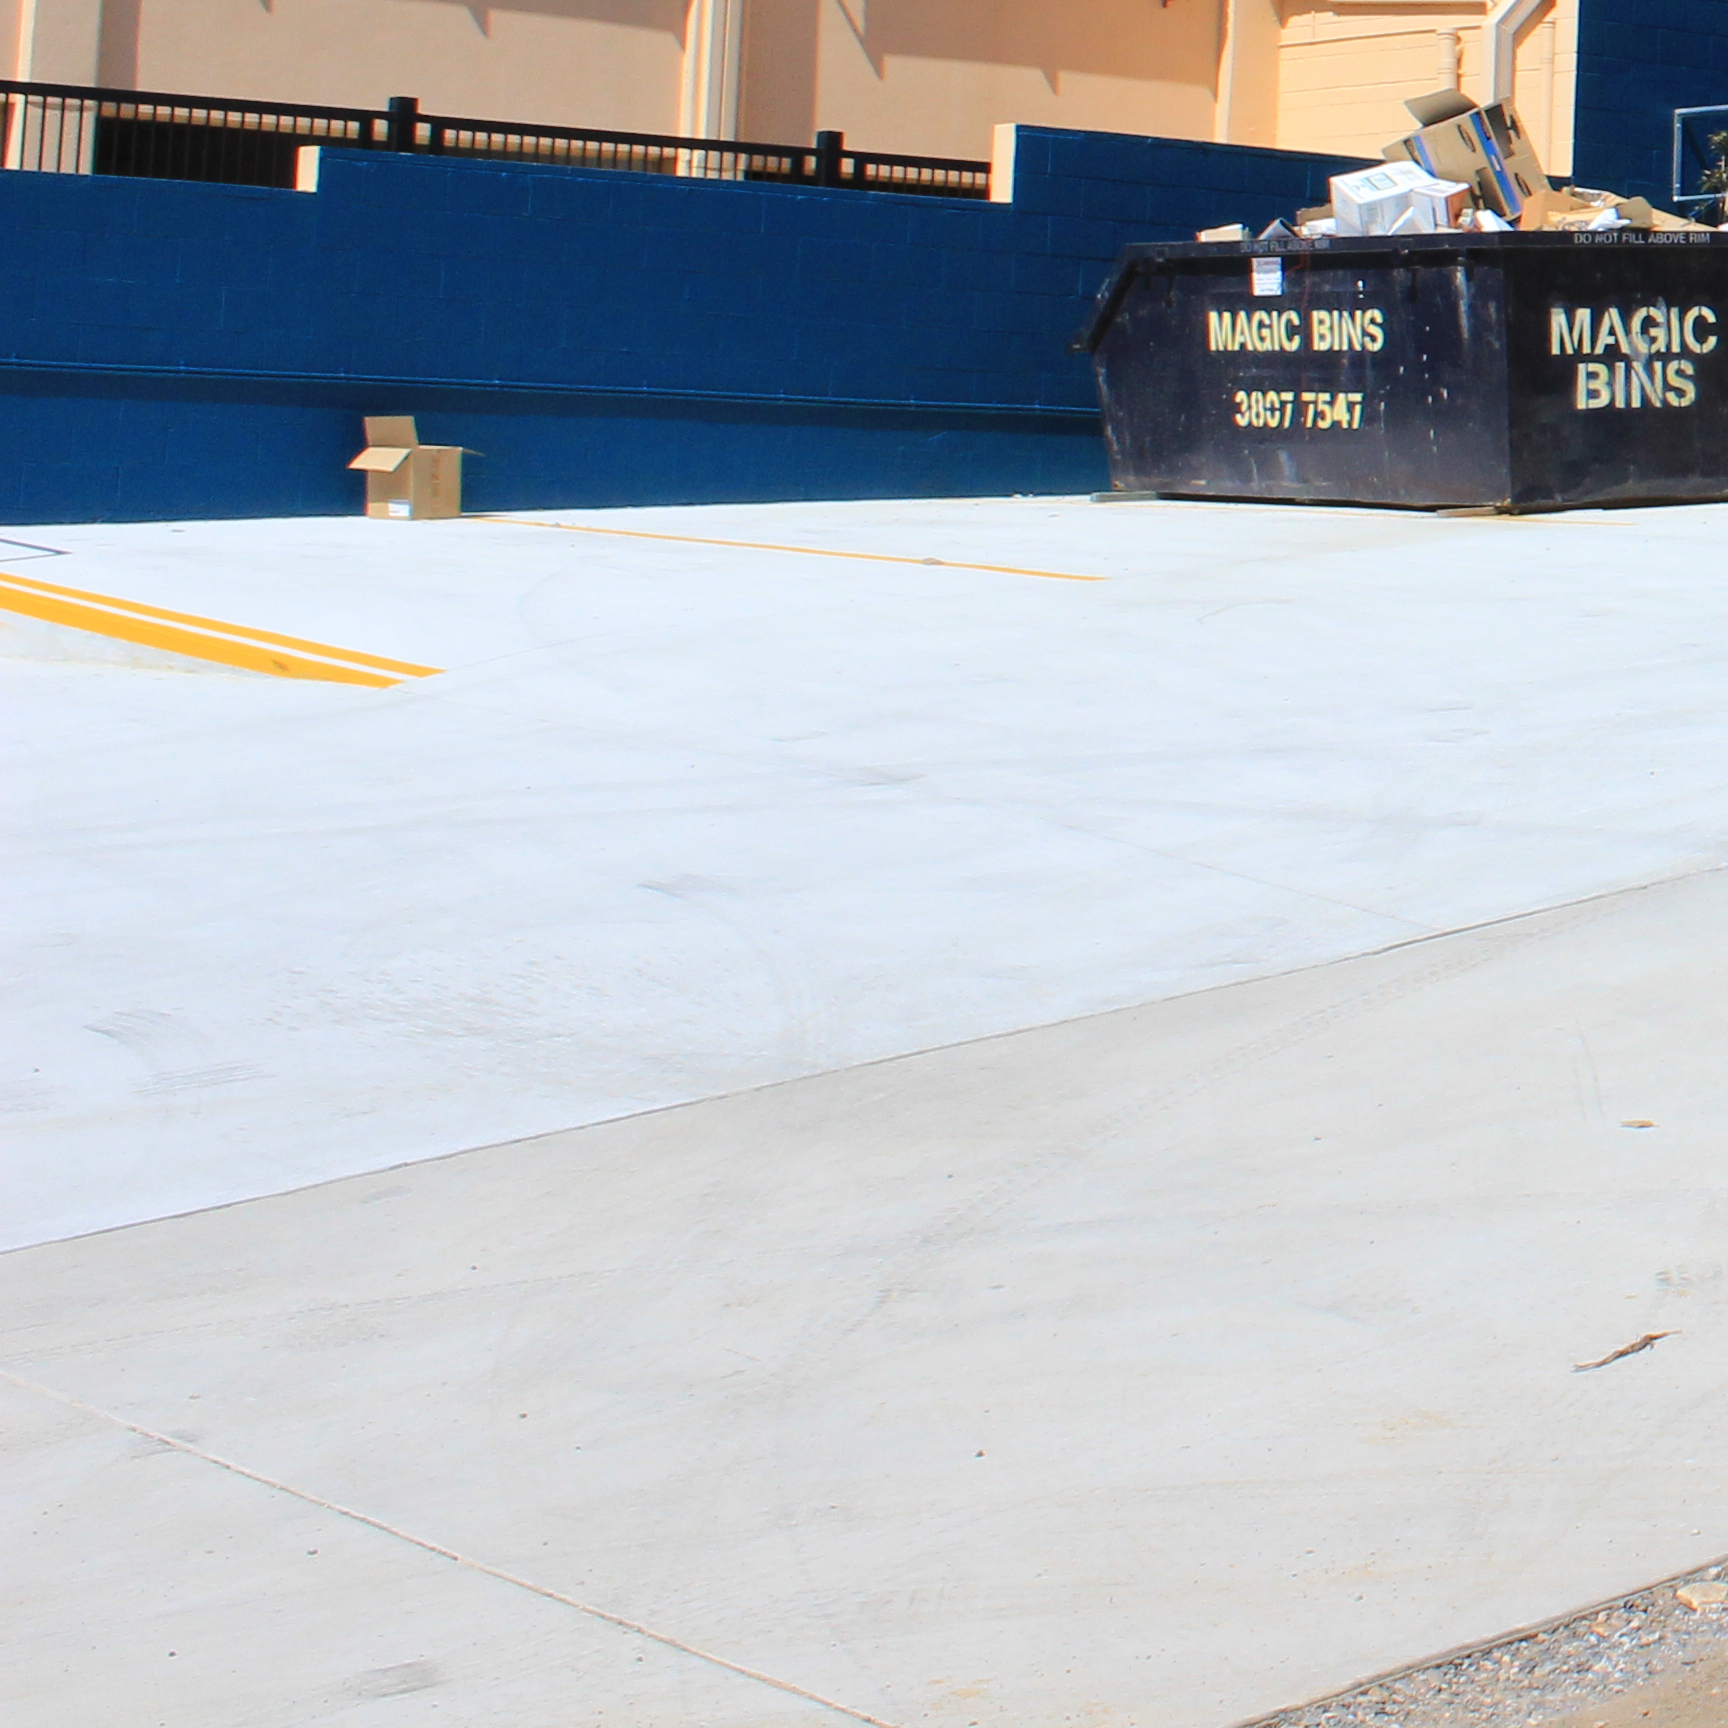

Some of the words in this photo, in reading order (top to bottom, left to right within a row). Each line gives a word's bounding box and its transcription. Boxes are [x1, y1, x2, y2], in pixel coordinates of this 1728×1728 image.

[1574, 233, 1592, 244] DO
[1595, 233, 1619, 244] NOT
[1622, 233, 1645, 244] FILL
[1648, 233, 1687, 244] ABOVE
[1689, 233, 1711, 244] RIM
[1208, 309, 1302, 353] MAGIC
[1311, 308, 1385, 353] BINS
[1550, 306, 1718, 355] MAGIC
[1575, 359, 1697, 410] BINS
[1234, 389, 1296, 429] 3807
[1301, 390, 1365, 430] 7547
